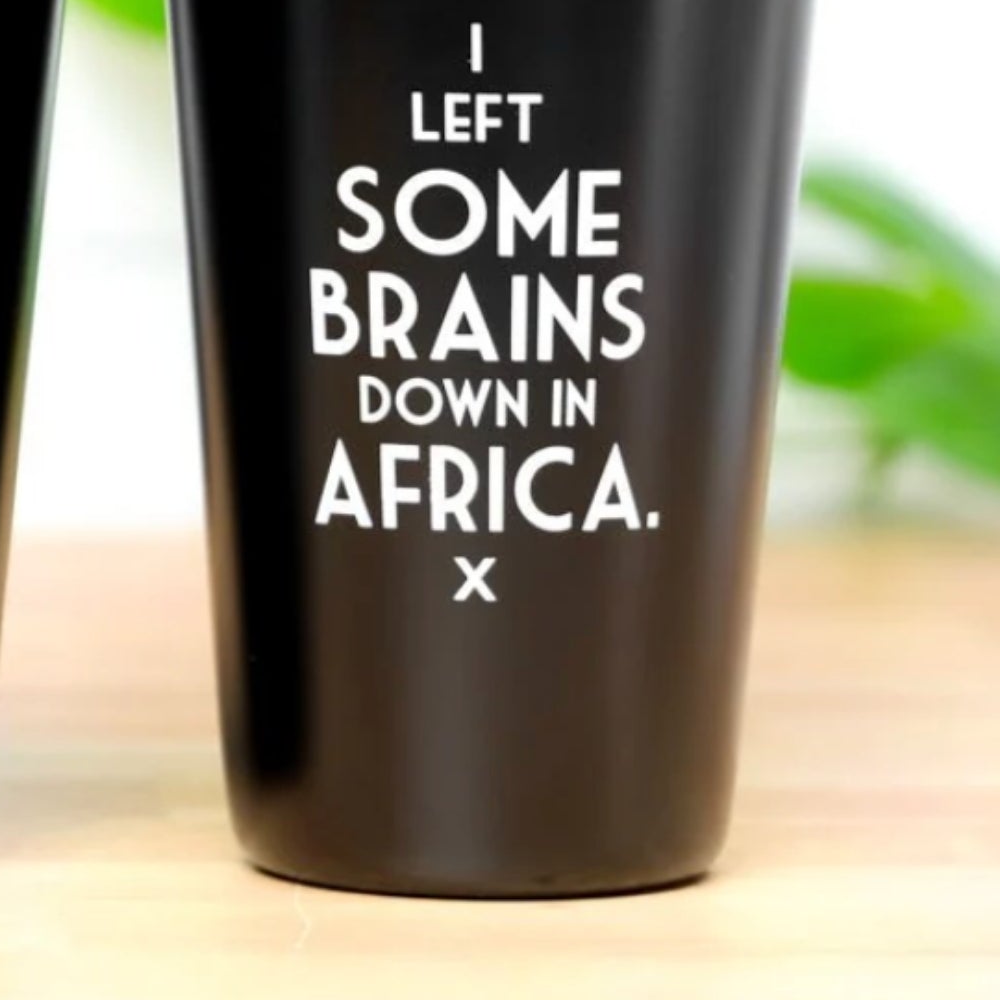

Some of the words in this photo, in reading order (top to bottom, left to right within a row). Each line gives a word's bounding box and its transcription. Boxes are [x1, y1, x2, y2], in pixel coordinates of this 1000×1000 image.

[471, 24, 482, 72] I
[412, 92, 542, 143] LEFT
[337, 166, 622, 257] SOME
[310, 268, 646, 362] BRAINS
[359, 375, 528, 428] DOWN
[552, 378, 597, 428] IN
[315, 439, 660, 532] AFRICA.
